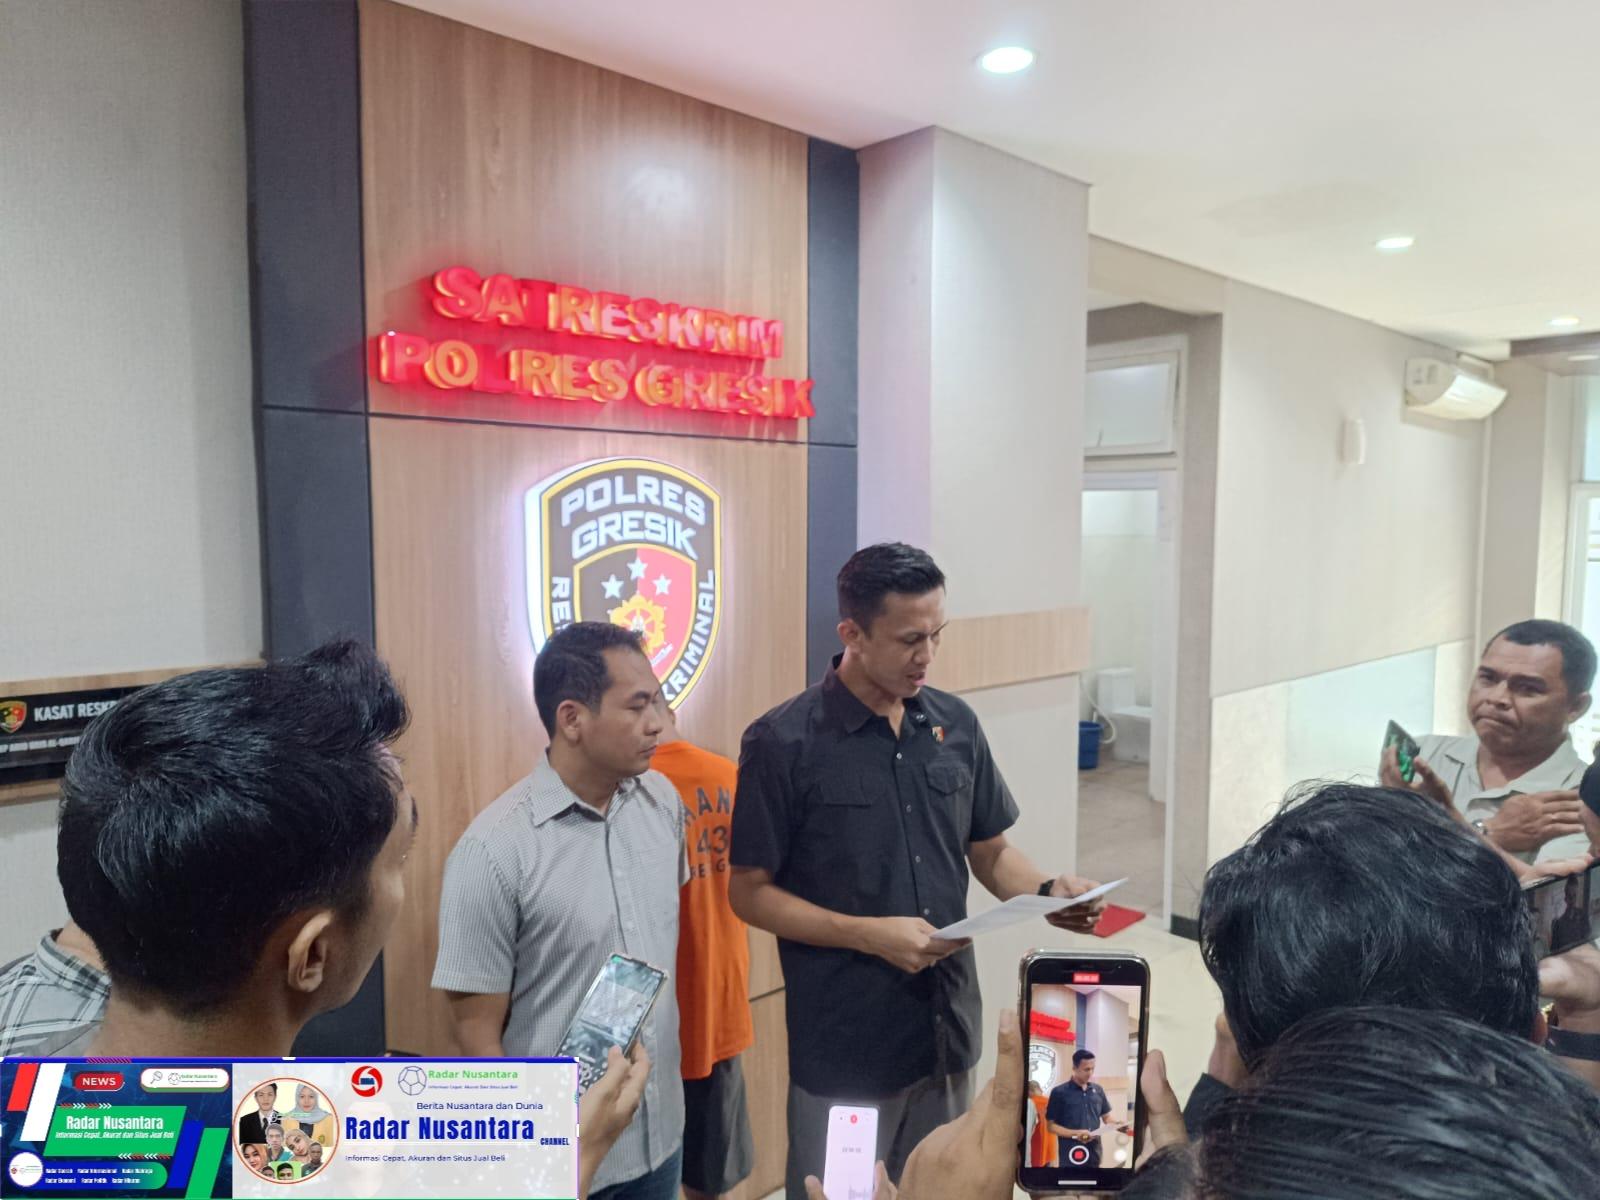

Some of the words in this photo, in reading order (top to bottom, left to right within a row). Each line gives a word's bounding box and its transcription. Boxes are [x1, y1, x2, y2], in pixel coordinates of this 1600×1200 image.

[634, 363, 815, 419] GRESIK
[561, 475, 706, 527] POLRES
[572, 510, 698, 560] GRESIK
[34, 703, 75, 722] KASAT
[696, 825, 728, 854] 43
